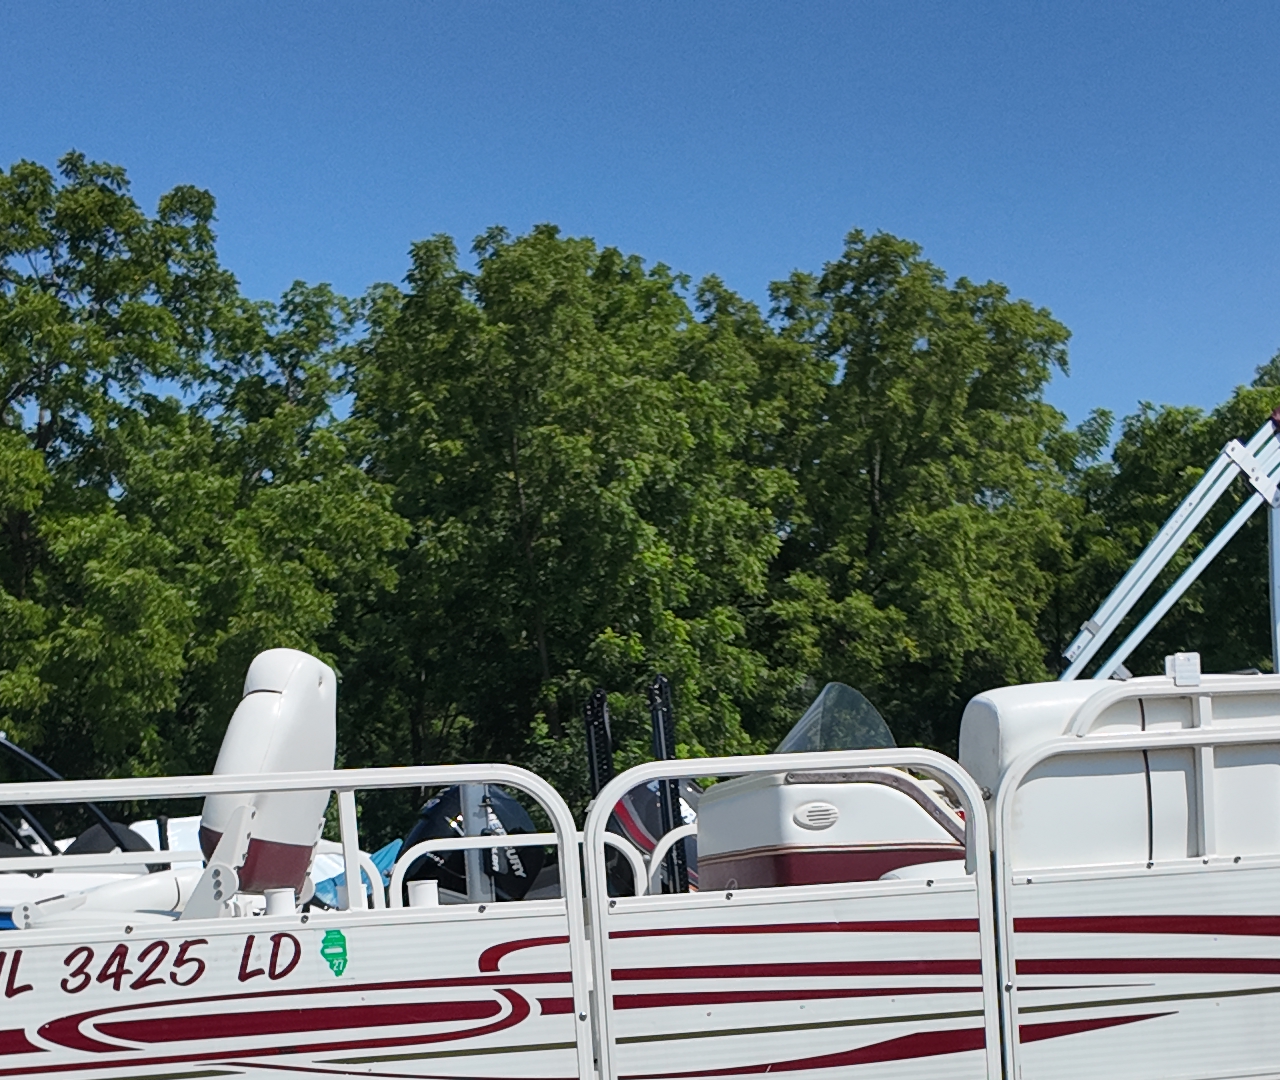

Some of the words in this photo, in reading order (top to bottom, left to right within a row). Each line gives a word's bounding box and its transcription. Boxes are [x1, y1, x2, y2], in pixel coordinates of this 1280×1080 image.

[60, 938, 209, 994] 3425
[238, 932, 302, 983] LD
[332, 959, 344, 971] 27
